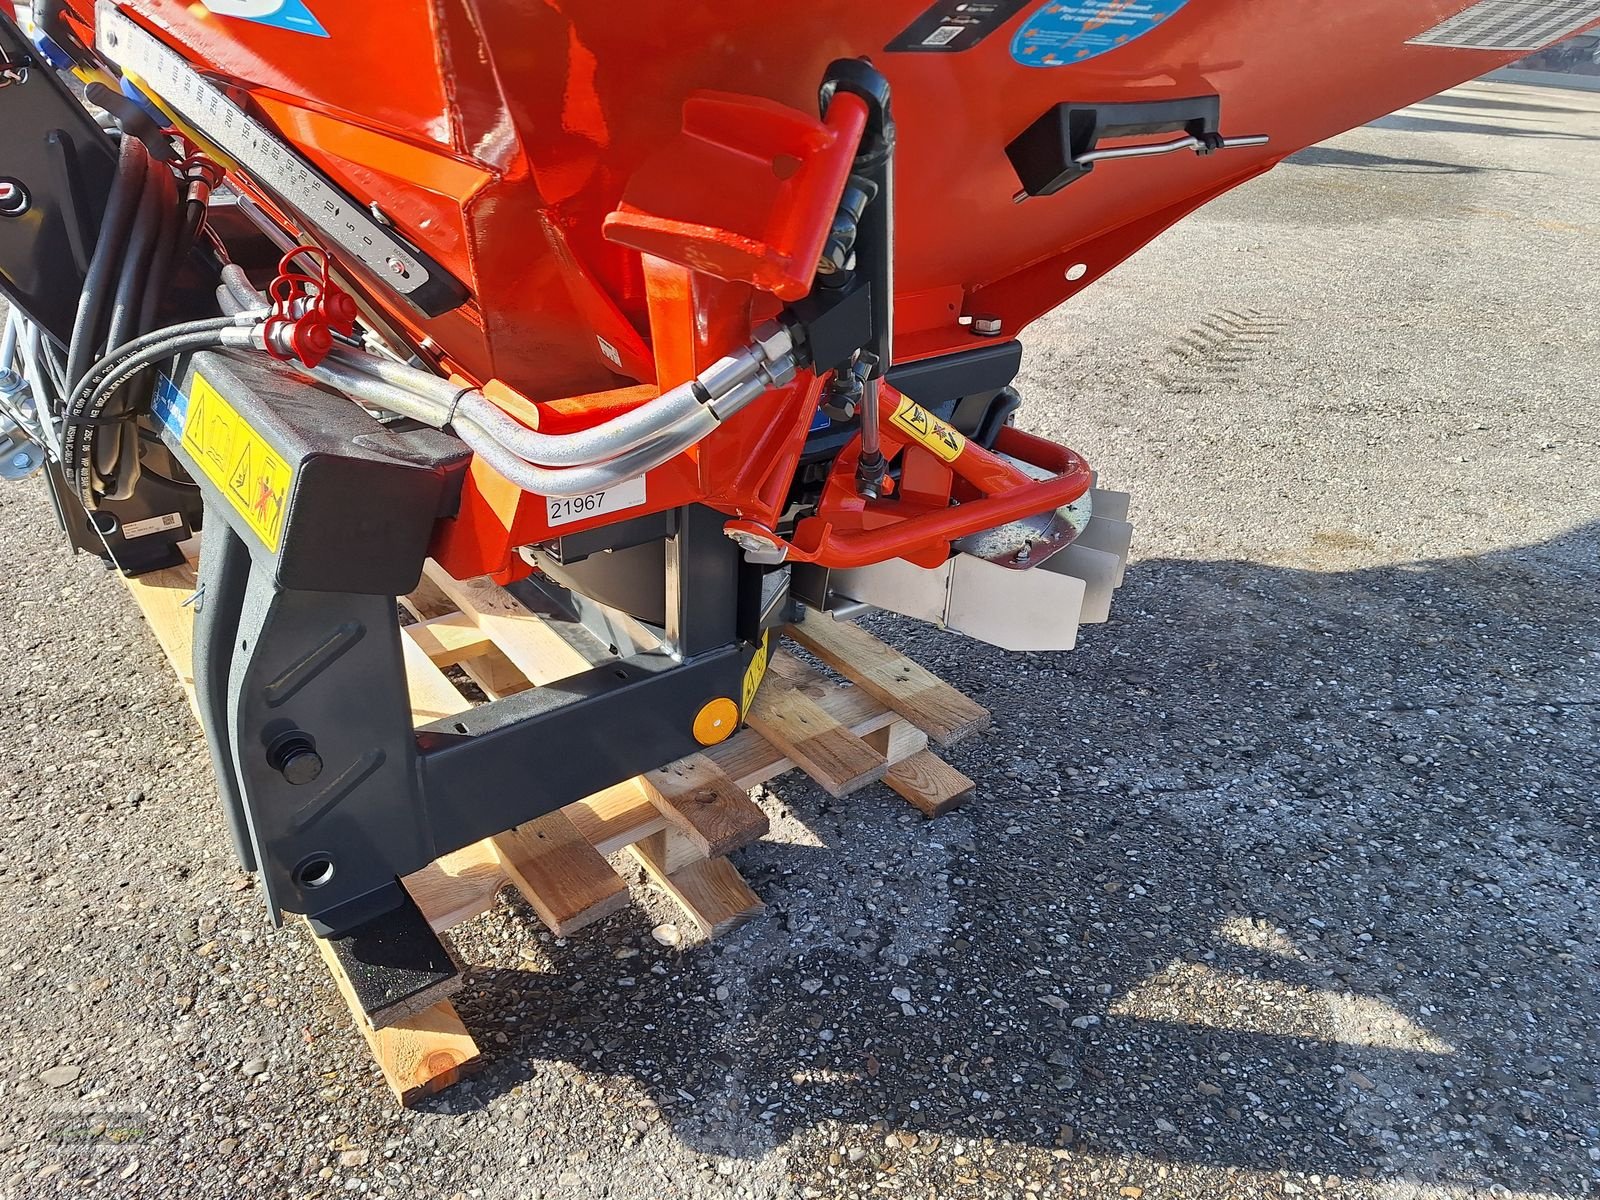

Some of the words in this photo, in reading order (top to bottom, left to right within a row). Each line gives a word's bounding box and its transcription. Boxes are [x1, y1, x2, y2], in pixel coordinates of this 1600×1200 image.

[172, 65, 180, 84] 400
[183, 75, 191, 94] 350
[195, 85, 204, 104] 300
[209, 96, 218, 116] 250
[224, 108, 234, 128] 200
[241, 122, 251, 139] 150
[260, 138, 270, 155] 100
[271, 147, 280, 160] 80
[277, 166, 285, 176] 60
[286, 159, 295, 172] 50
[290, 176, 298, 186] 40
[298, 169, 308, 182] 30
[302, 187, 310, 197] 20
[311, 180, 321, 191] 15
[323, 200, 335, 213] 10
[345, 222, 355, 231] 5
[362, 236, 373, 245] 0
[75, 398, 86, 409] 400
[66, 425, 77, 443] MSHA
[83, 429, 94, 441] 2SC
[81, 457, 89, 467] WP
[550, 491, 606, 520] 21967
